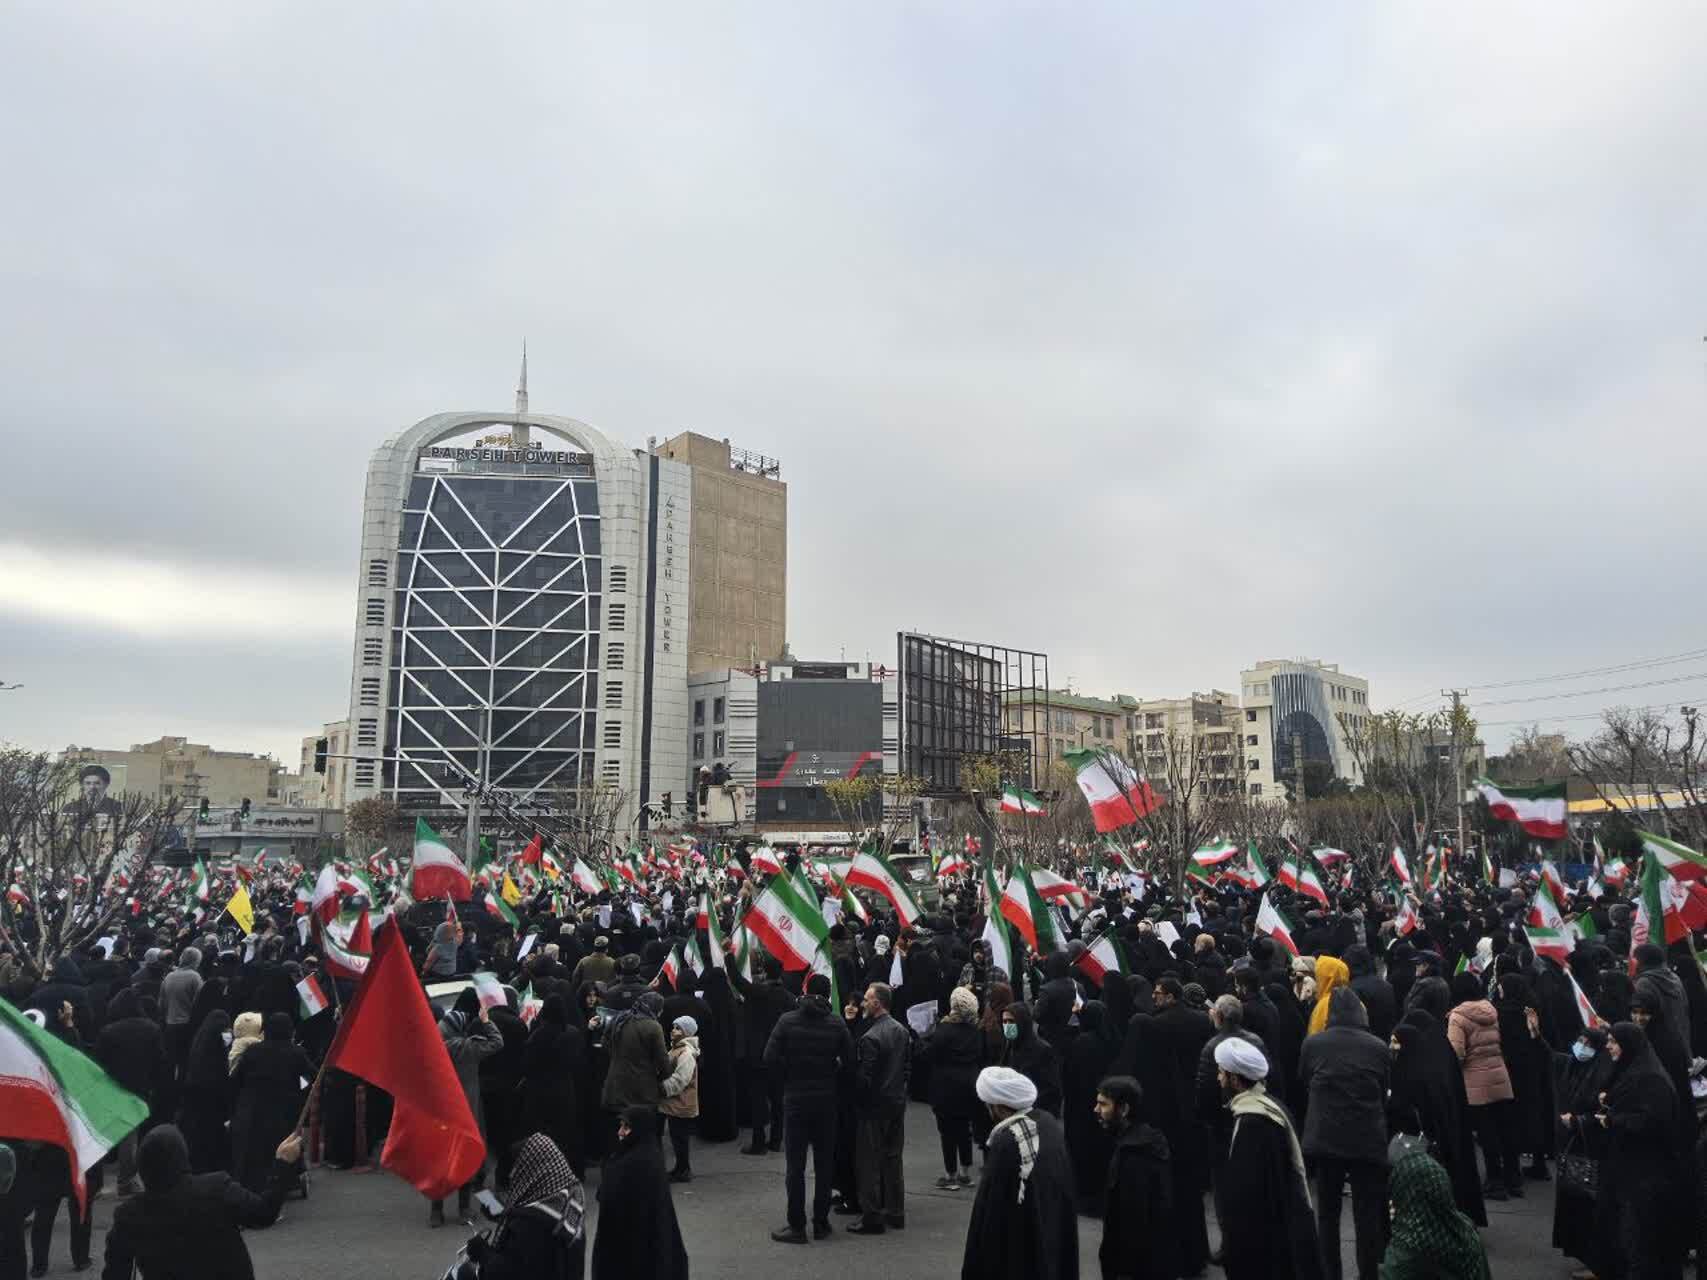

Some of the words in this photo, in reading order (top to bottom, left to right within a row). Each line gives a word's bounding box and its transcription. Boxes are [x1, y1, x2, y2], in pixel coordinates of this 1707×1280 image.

[431, 447, 505, 461] PARSEH
[512, 449, 578, 464] TOWER
[663, 592, 672, 652] TOWER
